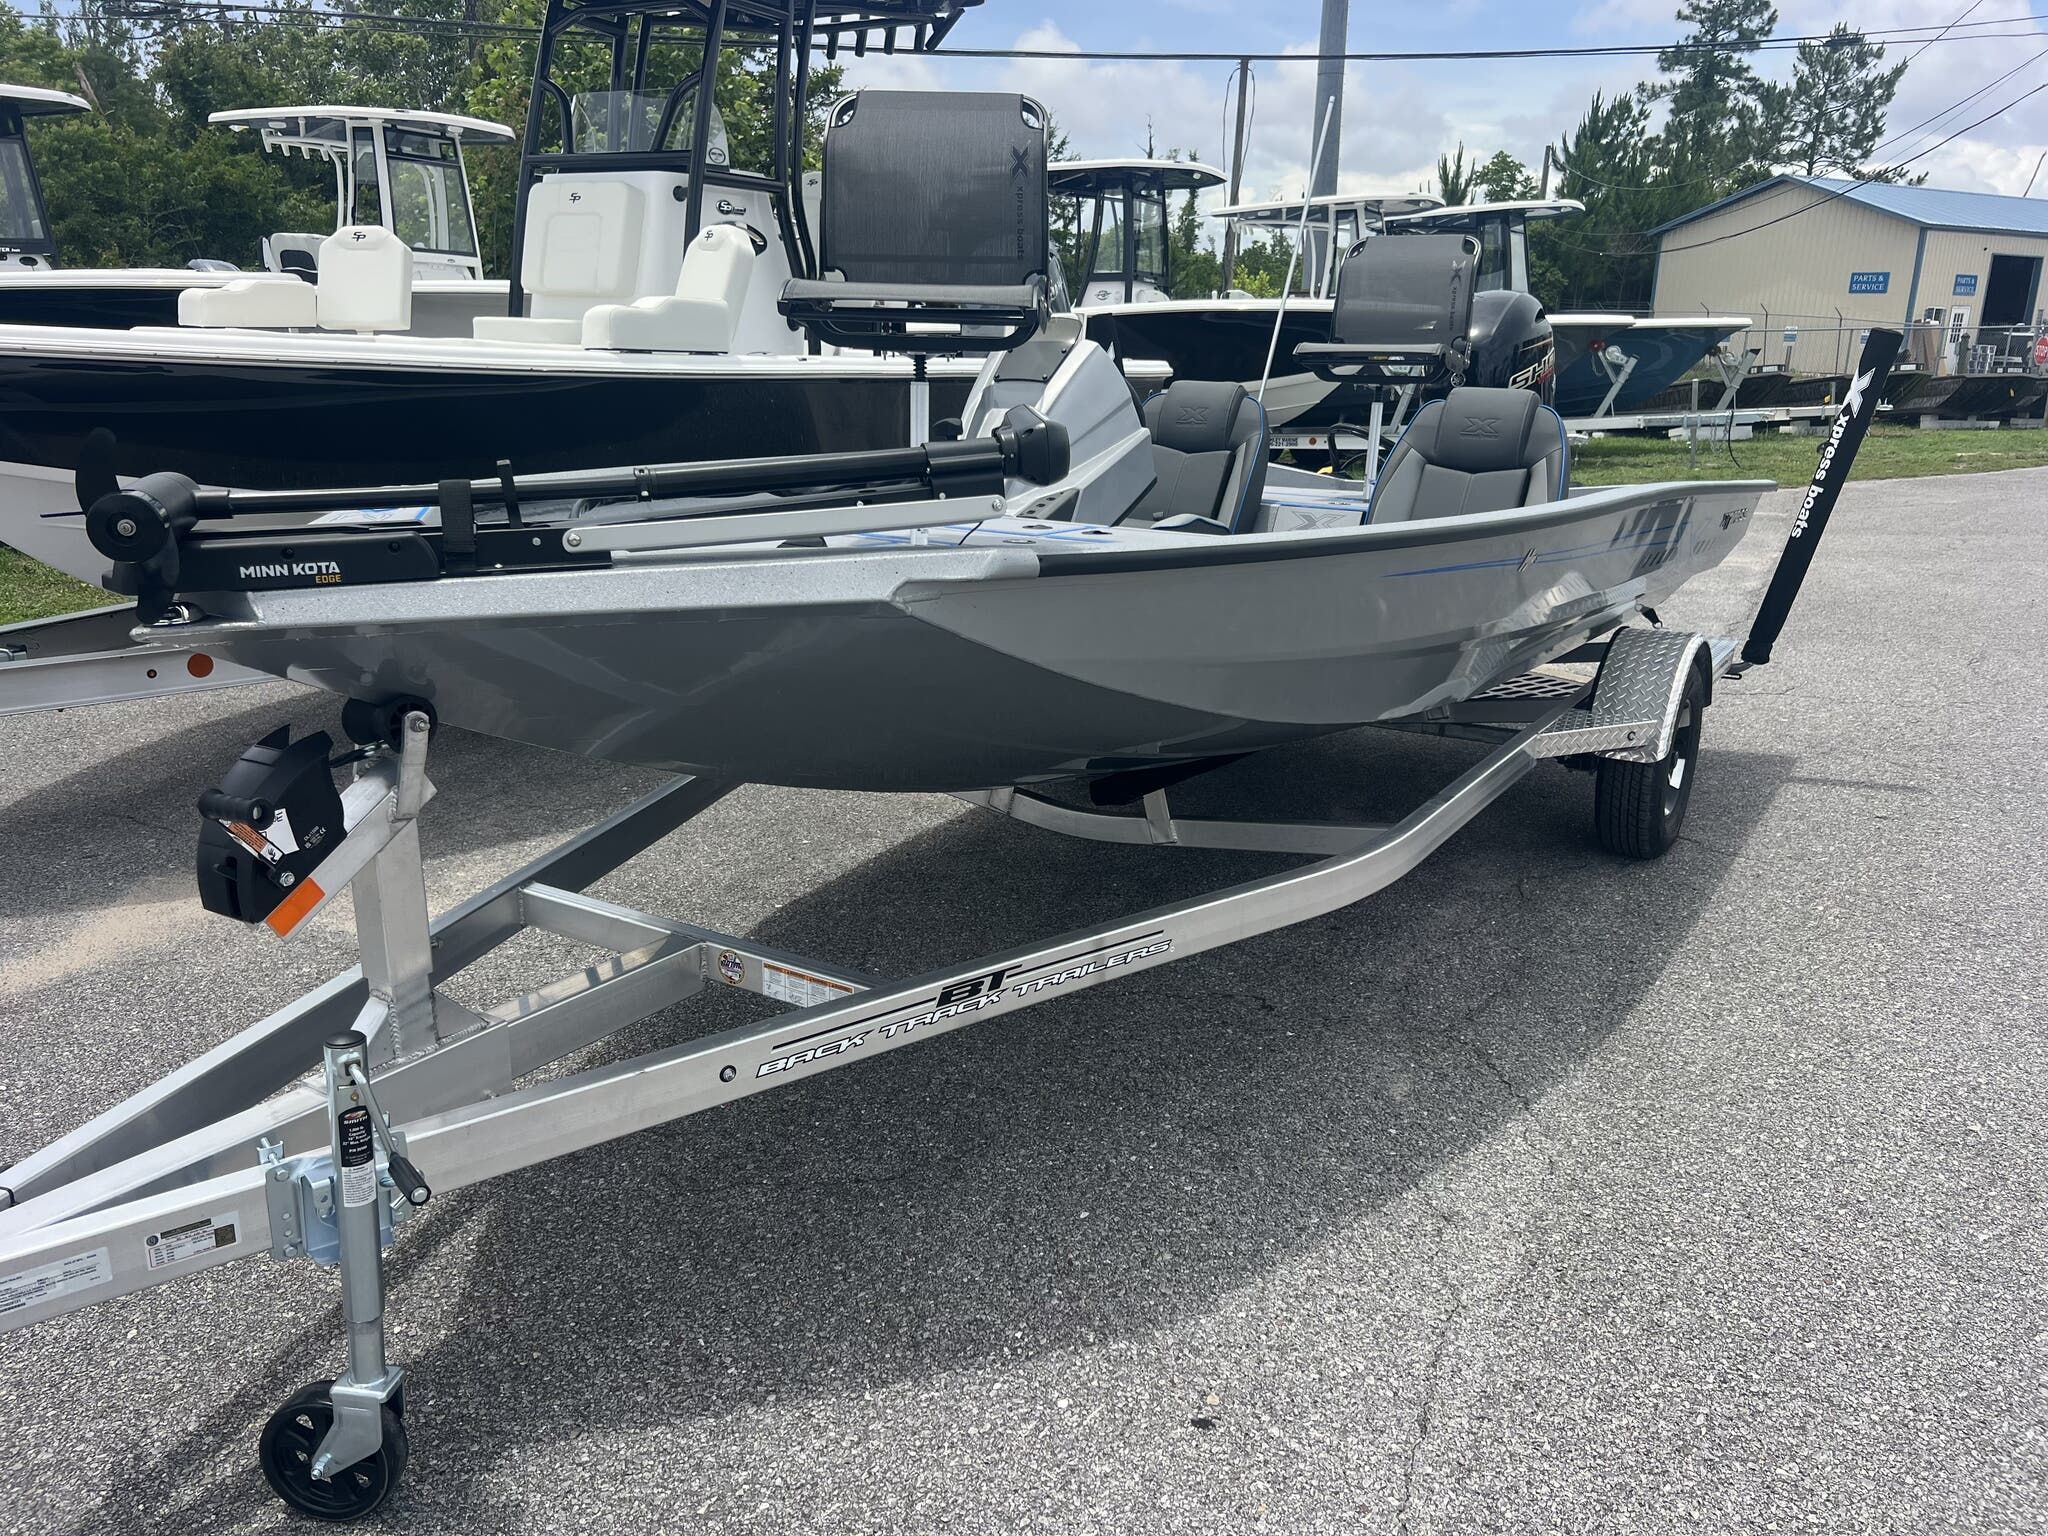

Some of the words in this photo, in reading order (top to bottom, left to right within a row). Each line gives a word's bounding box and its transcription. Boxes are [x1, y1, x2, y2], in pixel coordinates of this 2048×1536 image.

[1852, 283, 1884, 291] SERVICE
[1815, 412, 1850, 481] xpress
[1791, 483, 1825, 539] boats
[239, 564, 289, 579] MINN
[292, 561, 341, 576] KOTA
[315, 574, 342, 584] EDGE
[756, 1030, 873, 1079] BACK
[880, 987, 1011, 1039] TRACK
[1012, 939, 1173, 998] TRAILERS
[935, 964, 1023, 1009] BT
